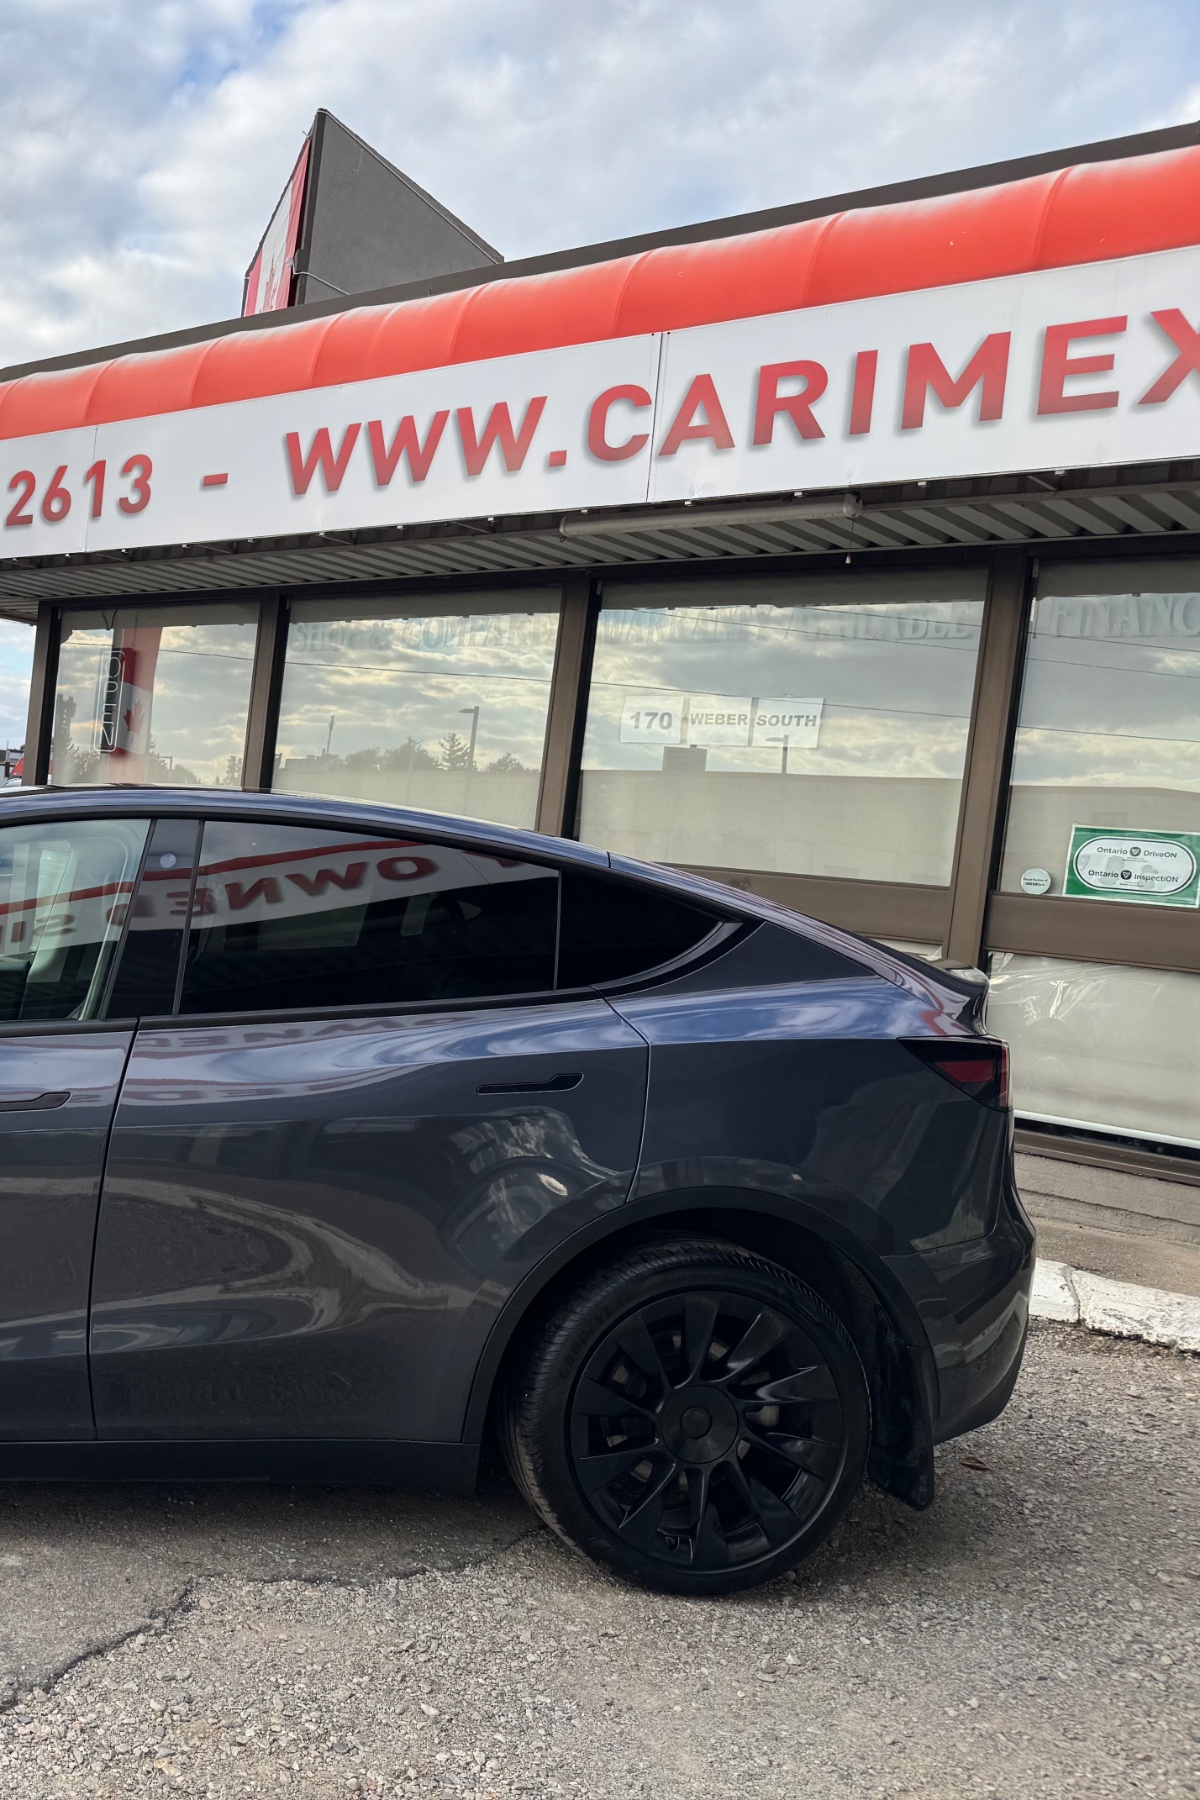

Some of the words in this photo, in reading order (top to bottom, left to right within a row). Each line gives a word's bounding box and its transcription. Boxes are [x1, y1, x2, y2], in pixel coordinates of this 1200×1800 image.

[285, 308, 1200, 496] WWW.CARIMEX
[100, 656, 121, 746] OPEN
[630, 712, 673, 730] 170
[690, 713, 748, 726] WEBER
[756, 714, 818, 727] SOUTH
[1096, 846, 1128, 855] Ontario
[1143, 850, 1178, 859] DriveON
[1088, 869, 1119, 878] Ontario
[1134, 873, 1179, 884] InspectiON
